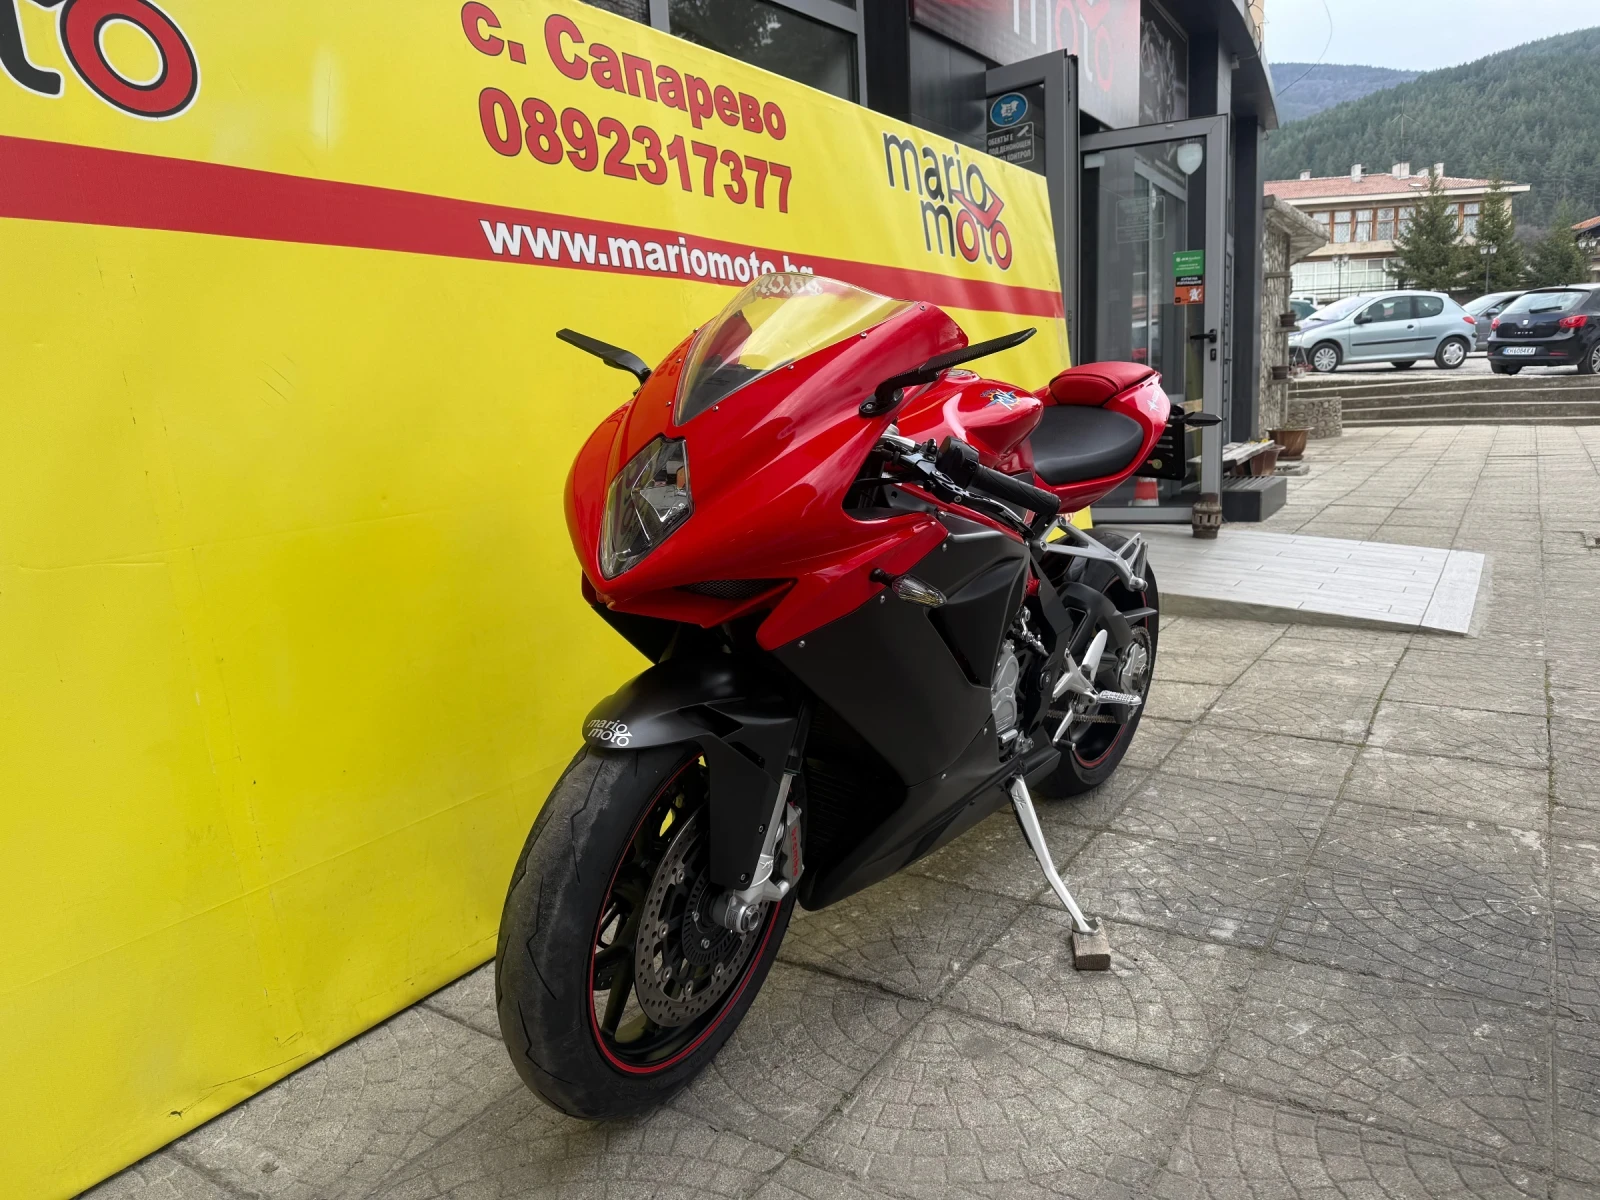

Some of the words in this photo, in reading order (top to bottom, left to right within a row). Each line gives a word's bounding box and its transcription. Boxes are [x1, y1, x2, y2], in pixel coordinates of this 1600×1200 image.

[460, 1, 527, 65] с.
[544, 13, 787, 140] Сапарево
[478, 87, 792, 214] 0892317377
[882, 131, 988, 213] mario
[479, 218, 814, 284] www.mariomotob
[919, 199, 1013, 271] moto
[586, 719, 628, 734] mario
[587, 728, 630, 747] moto
[791, 826, 799, 877] brembo
